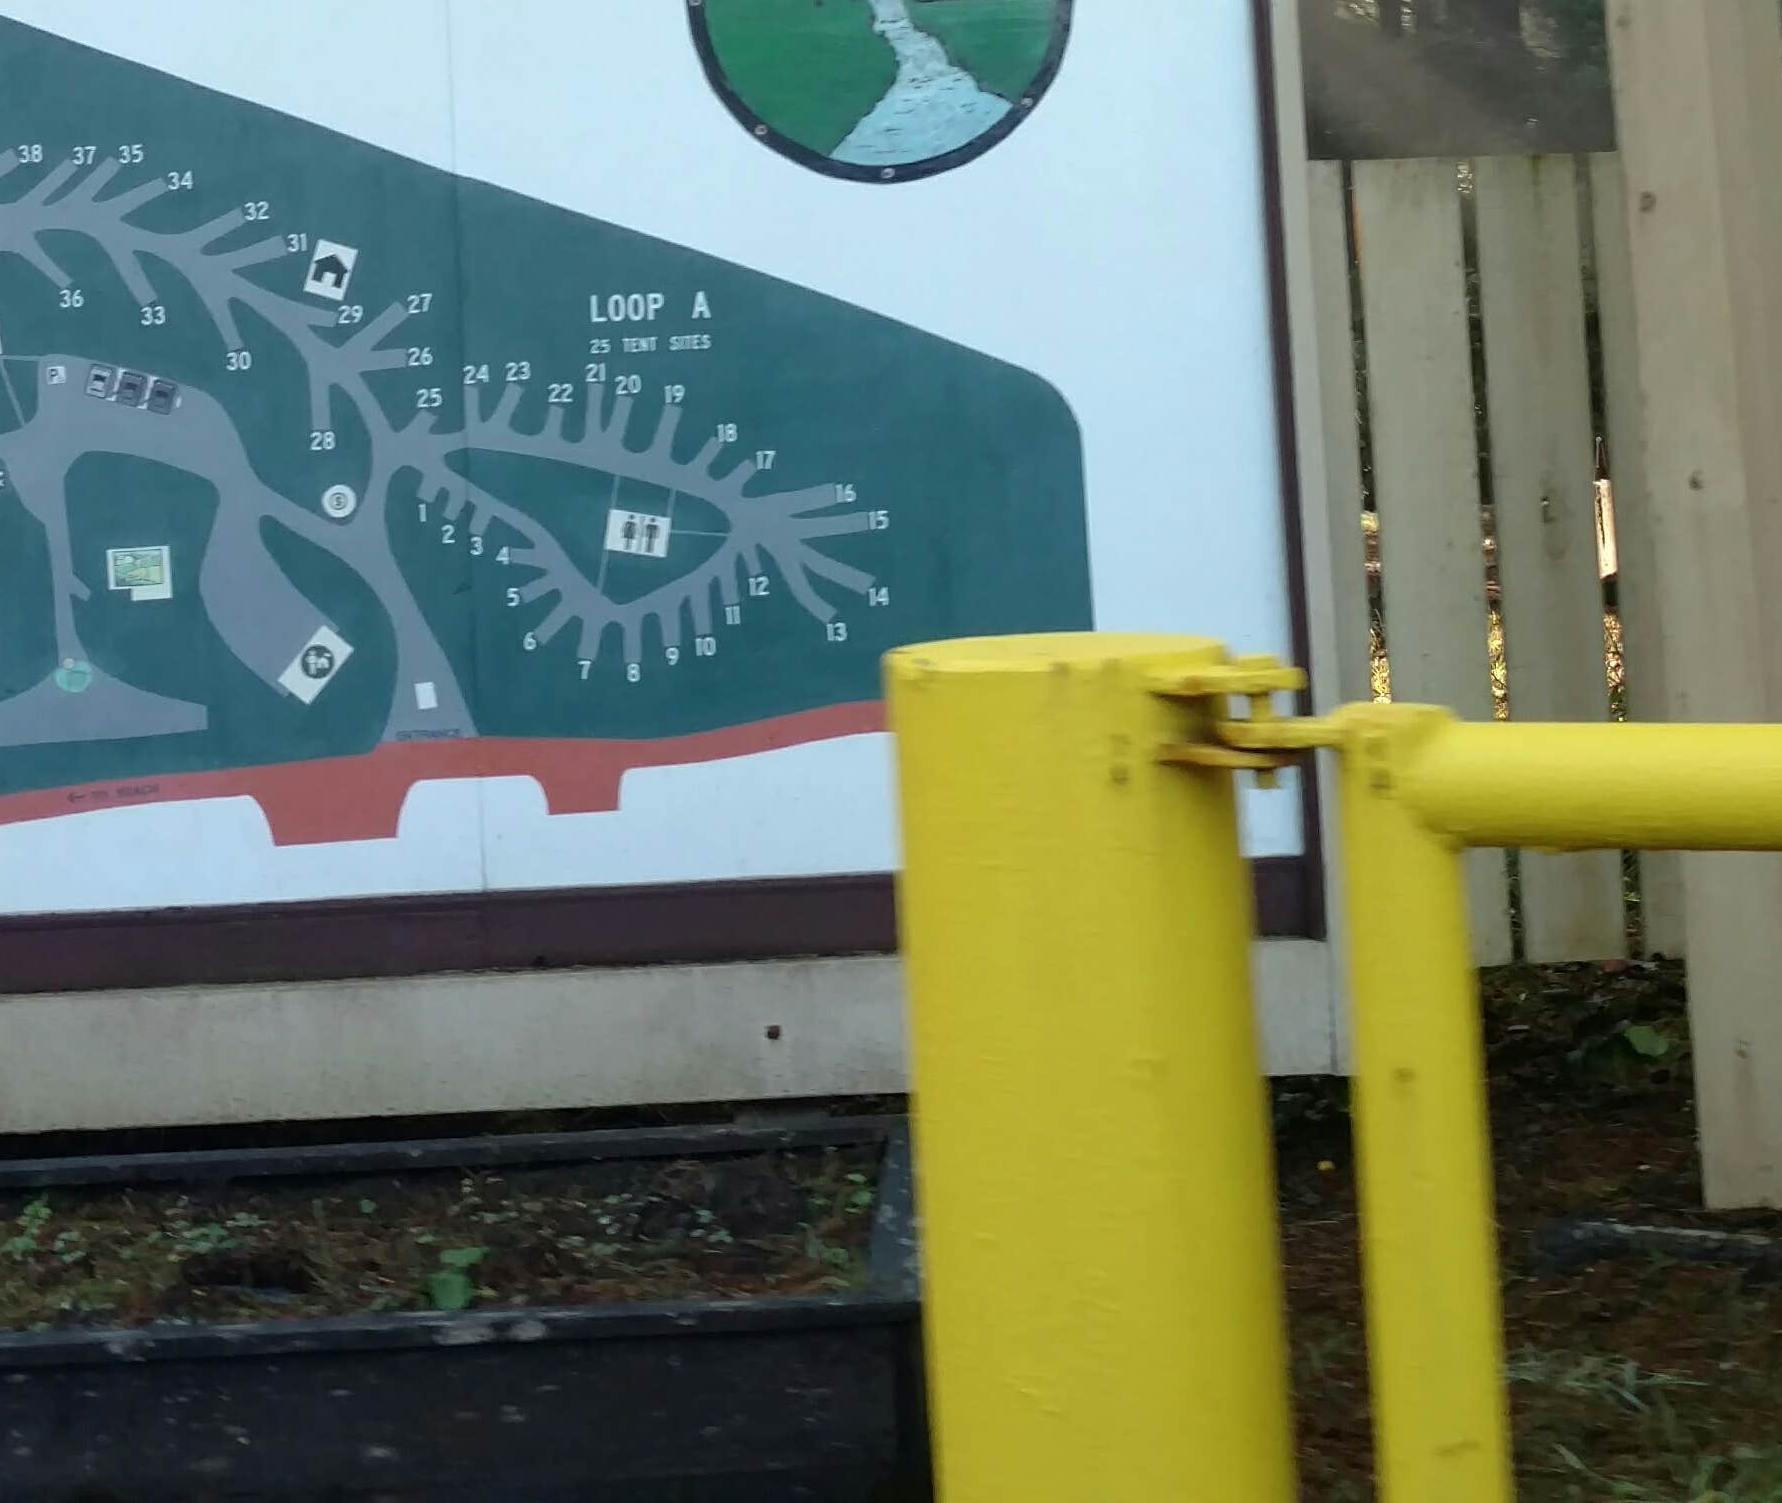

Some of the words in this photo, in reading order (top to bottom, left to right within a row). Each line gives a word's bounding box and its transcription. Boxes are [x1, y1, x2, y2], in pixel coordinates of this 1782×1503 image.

[18, 144, 43, 164] 38
[72, 145, 97, 165] 37
[118, 144, 144, 164] 35
[167, 170, 193, 190] 34
[244, 201, 270, 221] 32
[287, 233, 307, 253] 31
[59, 289, 84, 308] 36
[407, 293, 433, 314] 27
[590, 293, 665, 323] LOOP
[691, 291, 711, 319] A
[141, 305, 166, 326] 33
[338, 305, 363, 324] 29
[590, 339, 610, 354] 25
[622, 336, 656, 353] TENT
[670, 334, 711, 351] SITES
[226, 351, 252, 371] 30
[407, 347, 433, 366] 26
[463, 364, 489, 385] 24
[505, 361, 531, 381] 23
[585, 363, 606, 382] 21
[548, 383, 573, 403] 22
[615, 374, 641, 395] 20
[664, 384, 685, 403] 19
[416, 387, 442, 408] 25
[310, 431, 335, 451] 28
[717, 423, 737, 443] 18
[756, 450, 775, 470] 17
[836, 484, 856, 503] 16
[419, 504, 426, 522] 1
[868, 510, 888, 530] 15
[442, 524, 455, 544] 2
[470, 536, 483, 556] 3
[496, 546, 510, 564] 4
[749, 576, 769, 596] 12
[507, 587, 520, 607] 5
[868, 587, 889, 606] 14
[725, 606, 740, 625] 11
[524, 632, 536, 650] 6
[826, 622, 847, 642] 13
[666, 647, 679, 665] 9
[695, 637, 716, 656] 10
[579, 660, 592, 679] 7
[628, 663, 640, 682] 8
